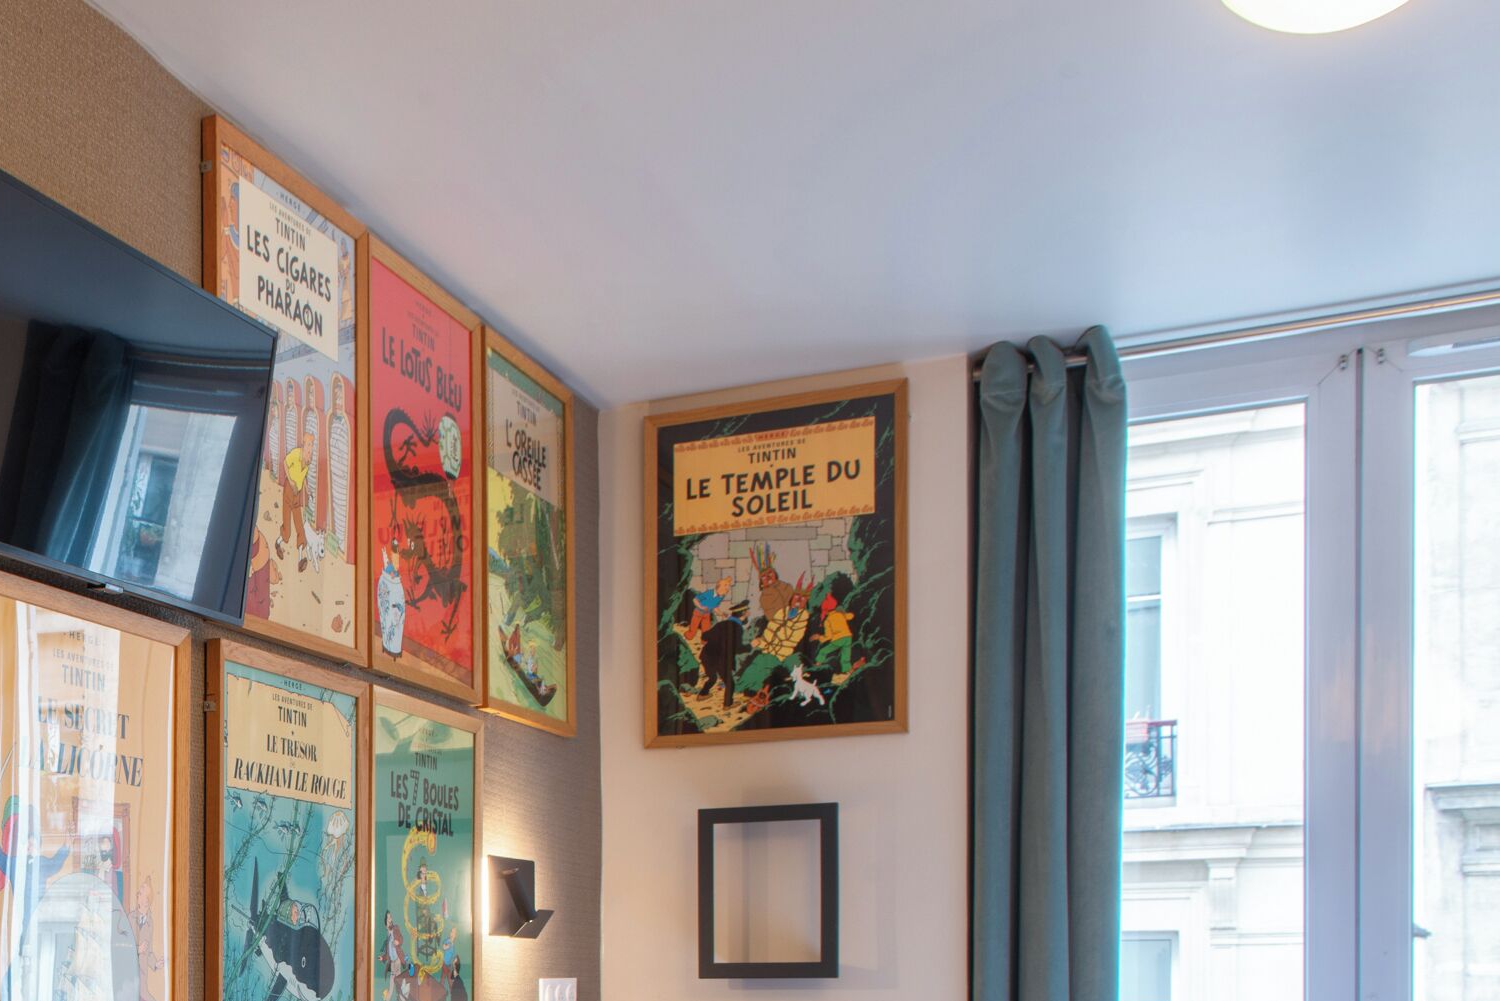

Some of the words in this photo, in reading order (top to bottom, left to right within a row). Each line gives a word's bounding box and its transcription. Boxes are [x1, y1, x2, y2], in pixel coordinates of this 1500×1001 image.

[276, 217, 306, 251] TINTIN
[247, 225, 270, 263] LES
[277, 247, 332, 303] CIGARES
[285, 279, 296, 295] DU
[257, 275, 323, 337] PHARAON
[412, 323, 435, 352] TINTIN
[382, 327, 395, 369] LE
[400, 340, 433, 393] LOTUS
[436, 366, 463, 412] BLEU
[516, 400, 537, 427] TINTIN
[748, 447, 796, 464] TINTIN
[686, 478, 711, 500] LE
[721, 464, 816, 495] TEMPLE
[827, 459, 861, 483] DU
[731, 489, 813, 518] SOLEIL
[62, 664, 105, 692] TINTIN
[278, 705, 307, 728] TINTIN
[267, 734, 278, 753] LE
[415, 751, 438, 770] TINTIN
[233, 758, 293, 789] RACKHAM
[295, 771, 309, 792] LE
[310, 774, 347, 800] ROUGE
[390, 771, 409, 800] LES
[410, 769, 420, 806] 7
[423, 778, 459, 811] BOULES
[398, 802, 412, 829] DE
[415, 806, 454, 837] CRISTAL
